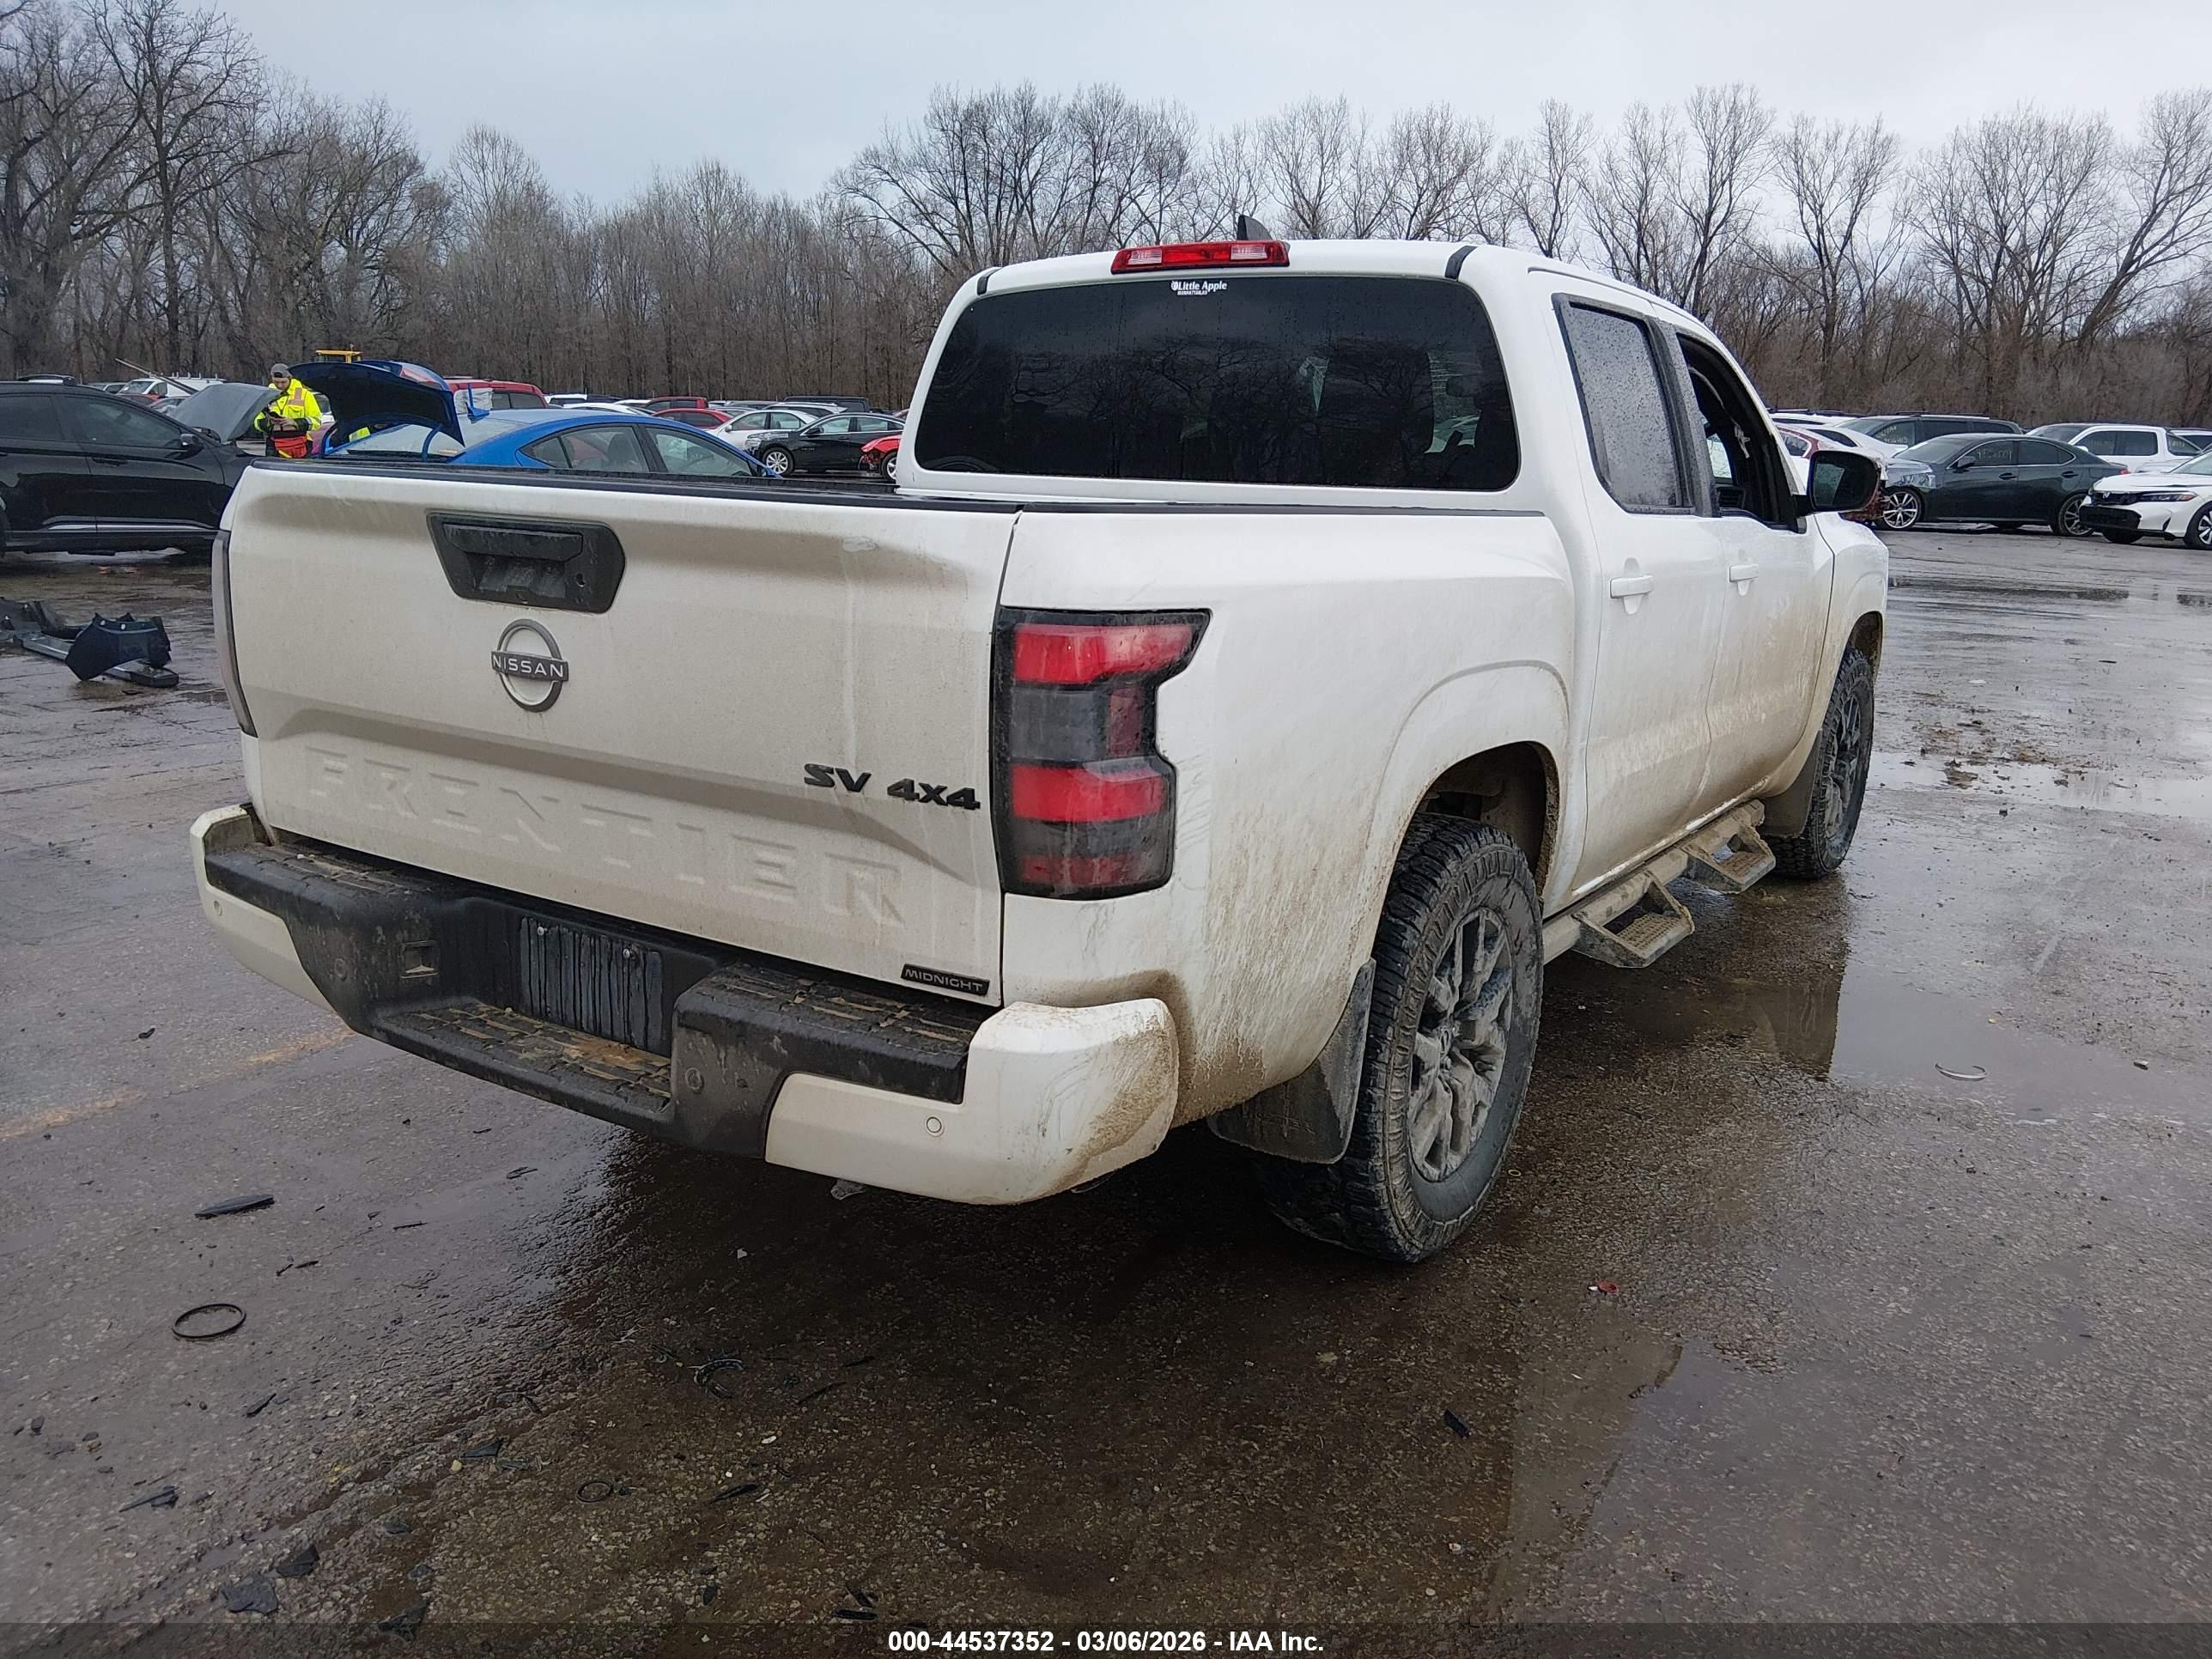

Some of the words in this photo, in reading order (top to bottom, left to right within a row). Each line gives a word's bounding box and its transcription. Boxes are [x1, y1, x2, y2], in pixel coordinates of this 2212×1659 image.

[1177, 281, 1200, 290] Little
[1201, 280, 1228, 293] Apple
[492, 654, 563, 678] NISSAN
[804, 763, 872, 793] SV
[305, 744, 906, 929] FRONTIER
[904, 969, 983, 992] MIDNIGHT
